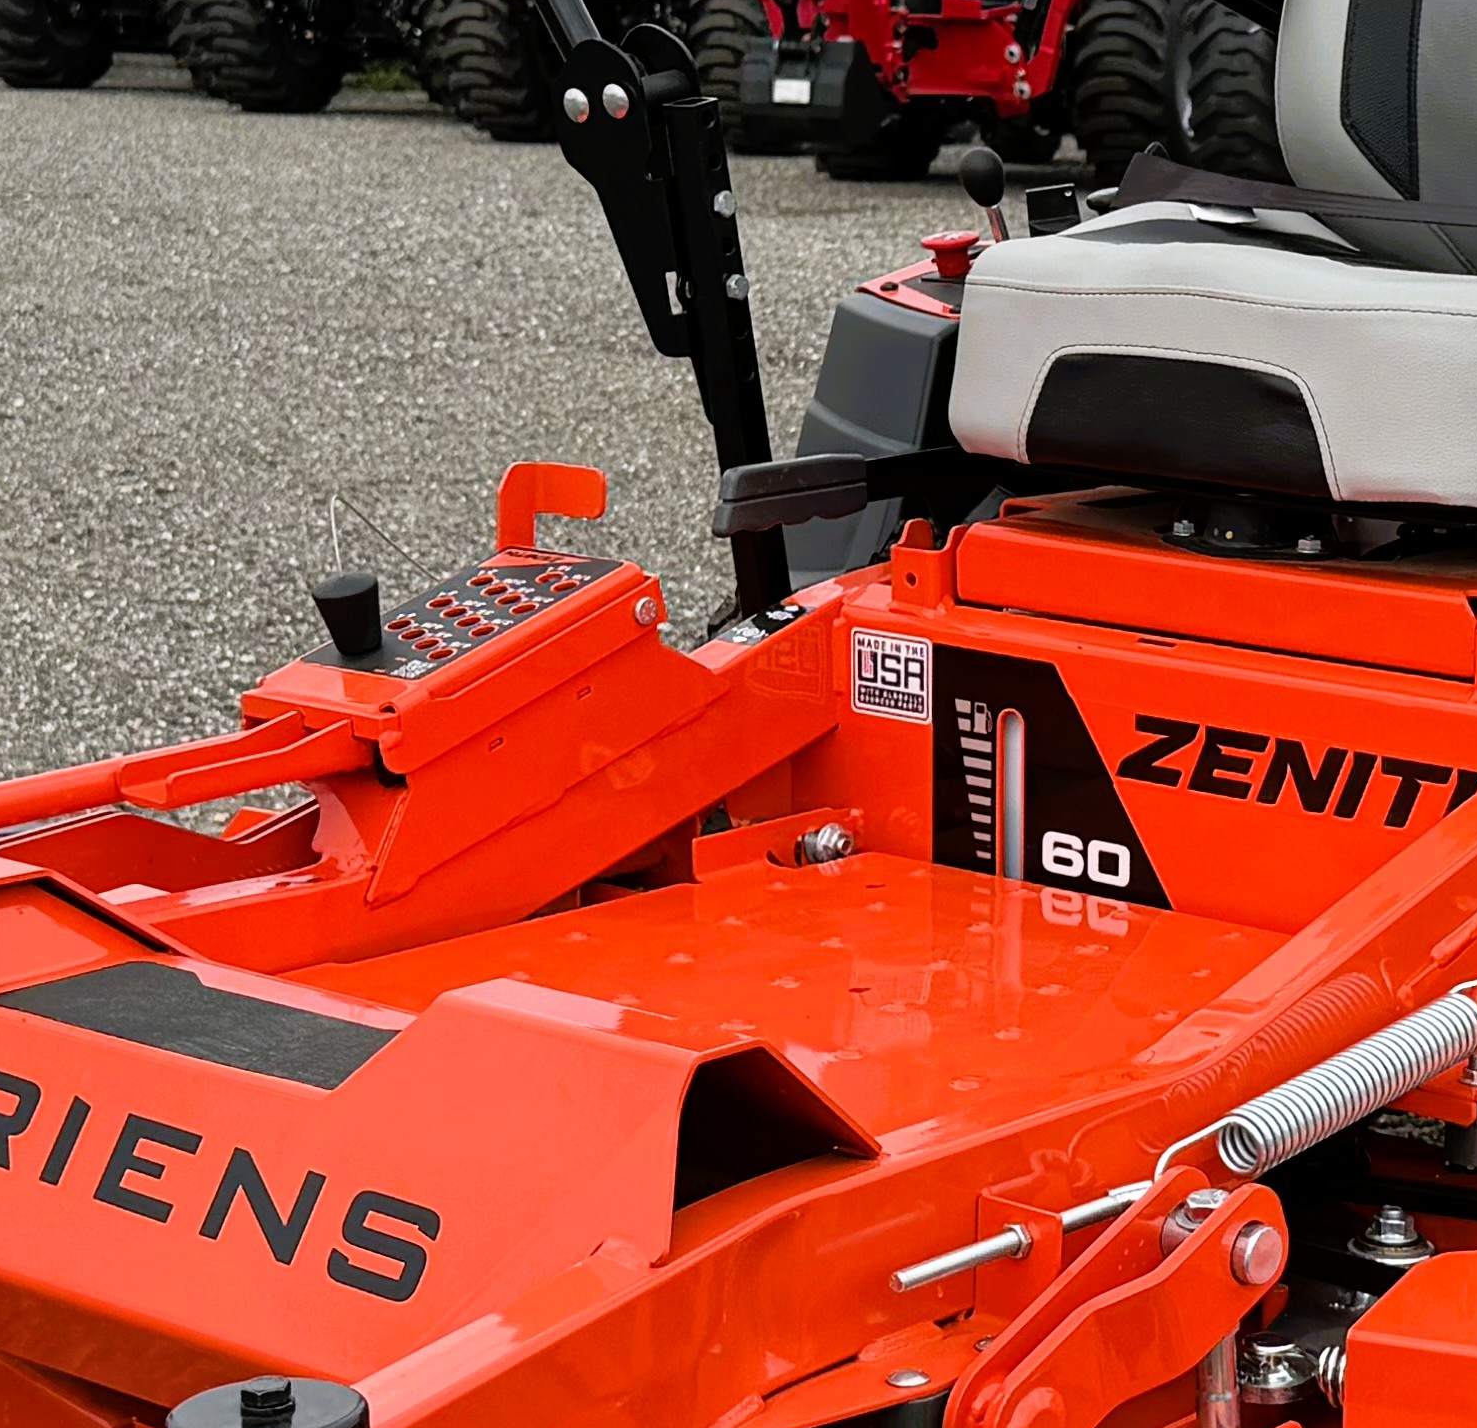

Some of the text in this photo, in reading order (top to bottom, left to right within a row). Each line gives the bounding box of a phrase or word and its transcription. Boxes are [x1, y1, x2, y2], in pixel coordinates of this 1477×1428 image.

[857, 637, 925, 658] MADE IN THE
[857, 648, 925, 693] USA
[1041, 830, 1131, 887] 60
